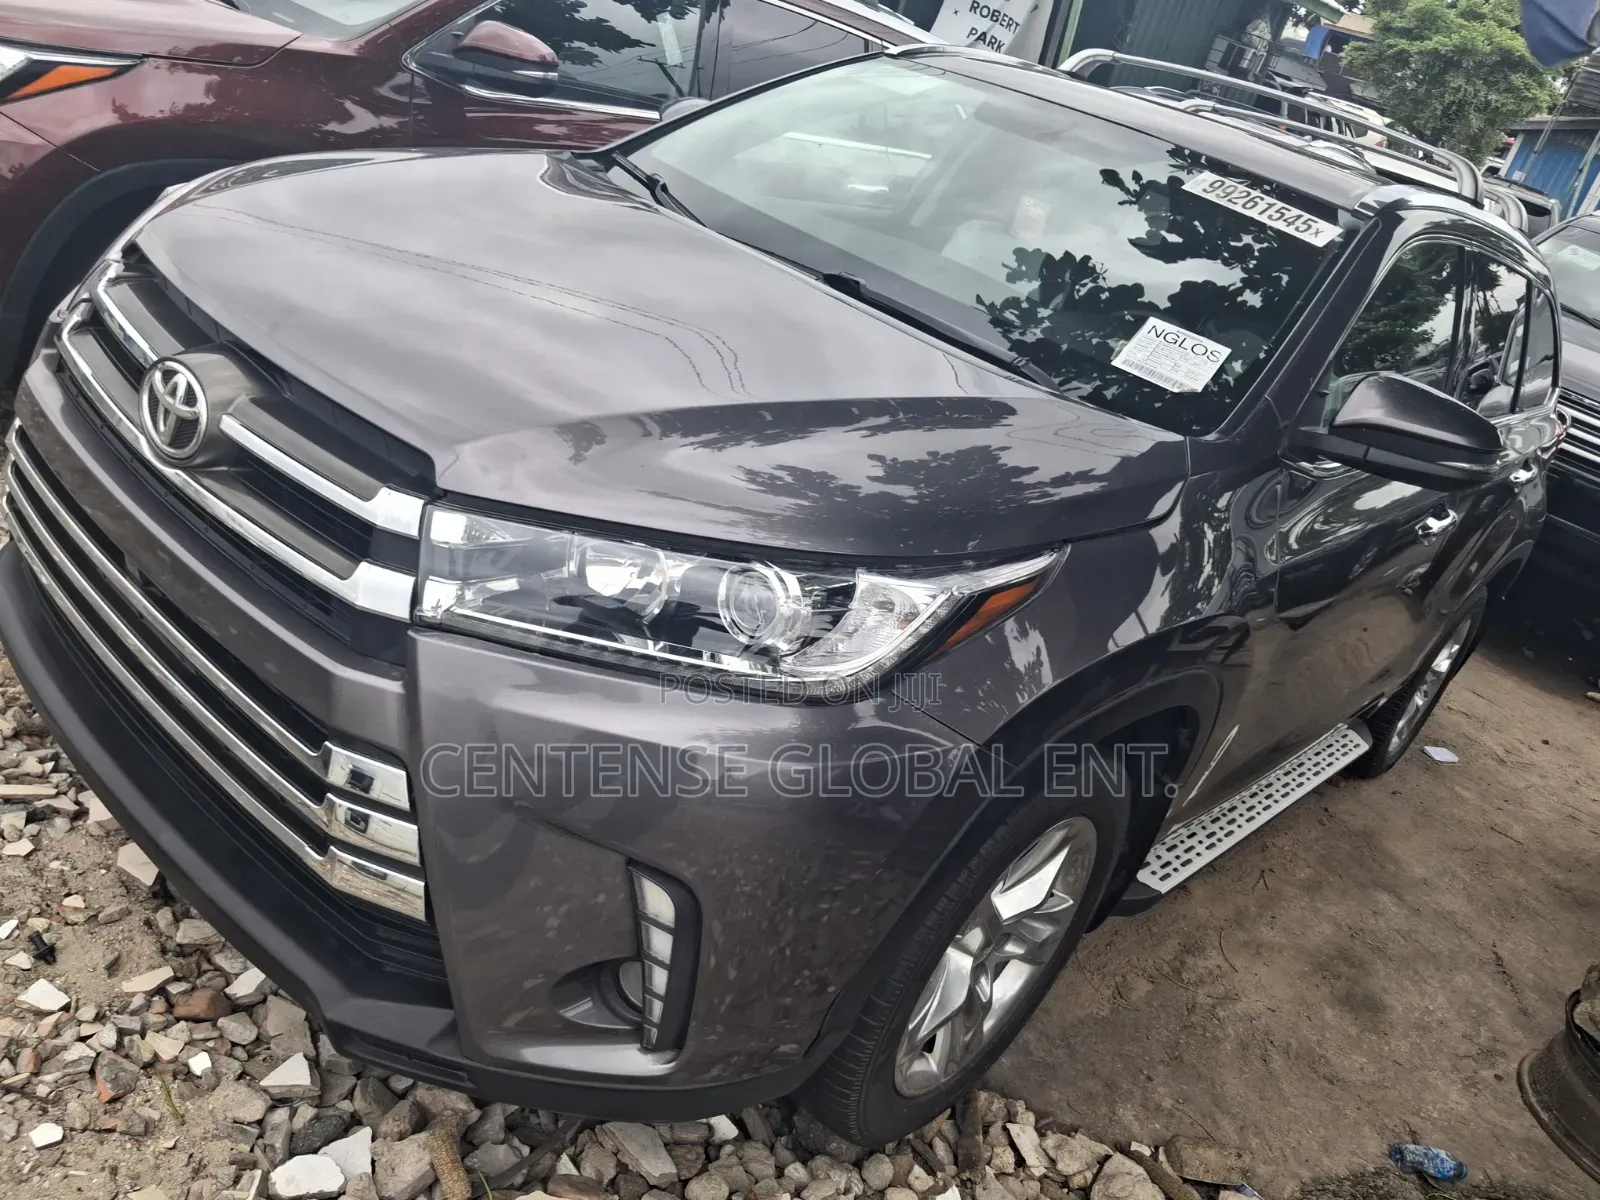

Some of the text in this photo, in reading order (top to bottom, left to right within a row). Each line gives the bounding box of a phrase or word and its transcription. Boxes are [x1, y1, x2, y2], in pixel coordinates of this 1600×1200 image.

[968, 0, 1020, 35] ROBERT
[966, 26, 1006, 54] PARK
[1147, 325, 1222, 363] NGLOS
